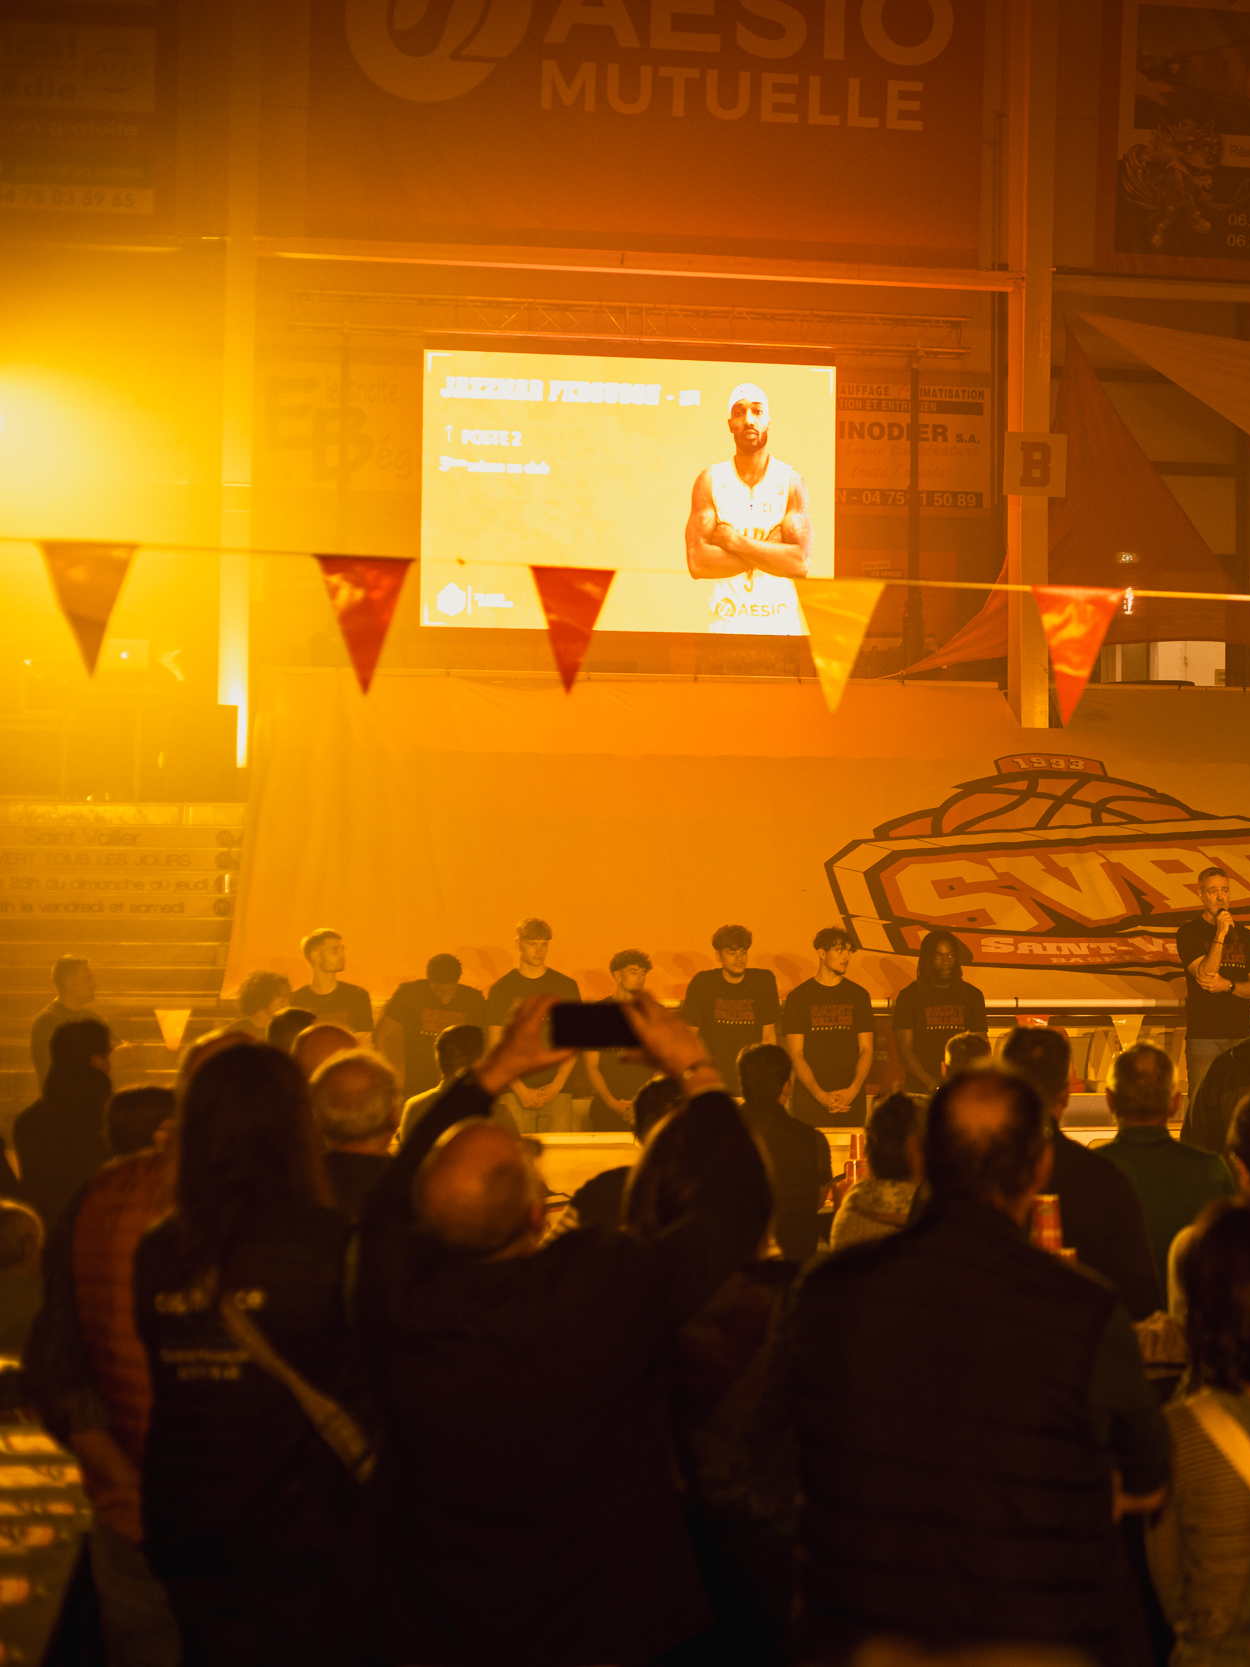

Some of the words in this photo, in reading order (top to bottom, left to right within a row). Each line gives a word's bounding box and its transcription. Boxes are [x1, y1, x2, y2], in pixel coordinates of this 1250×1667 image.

[540, 58, 924, 131] MUTUELLE
[461, 429, 509, 446] POSTE
[511, 431, 522, 447] 2
[1019, 441, 1052, 487] B
[862, 491, 882, 504] 04
[886, 492, 906, 505] 75
[933, 493, 953, 507] 50
[1013, 756, 1087, 771] 1993
[23, 828, 75, 846] Saint
[43, 853, 91, 867] TOUS
[96, 853, 128, 867] LES
[133, 853, 192, 867] JOURS
